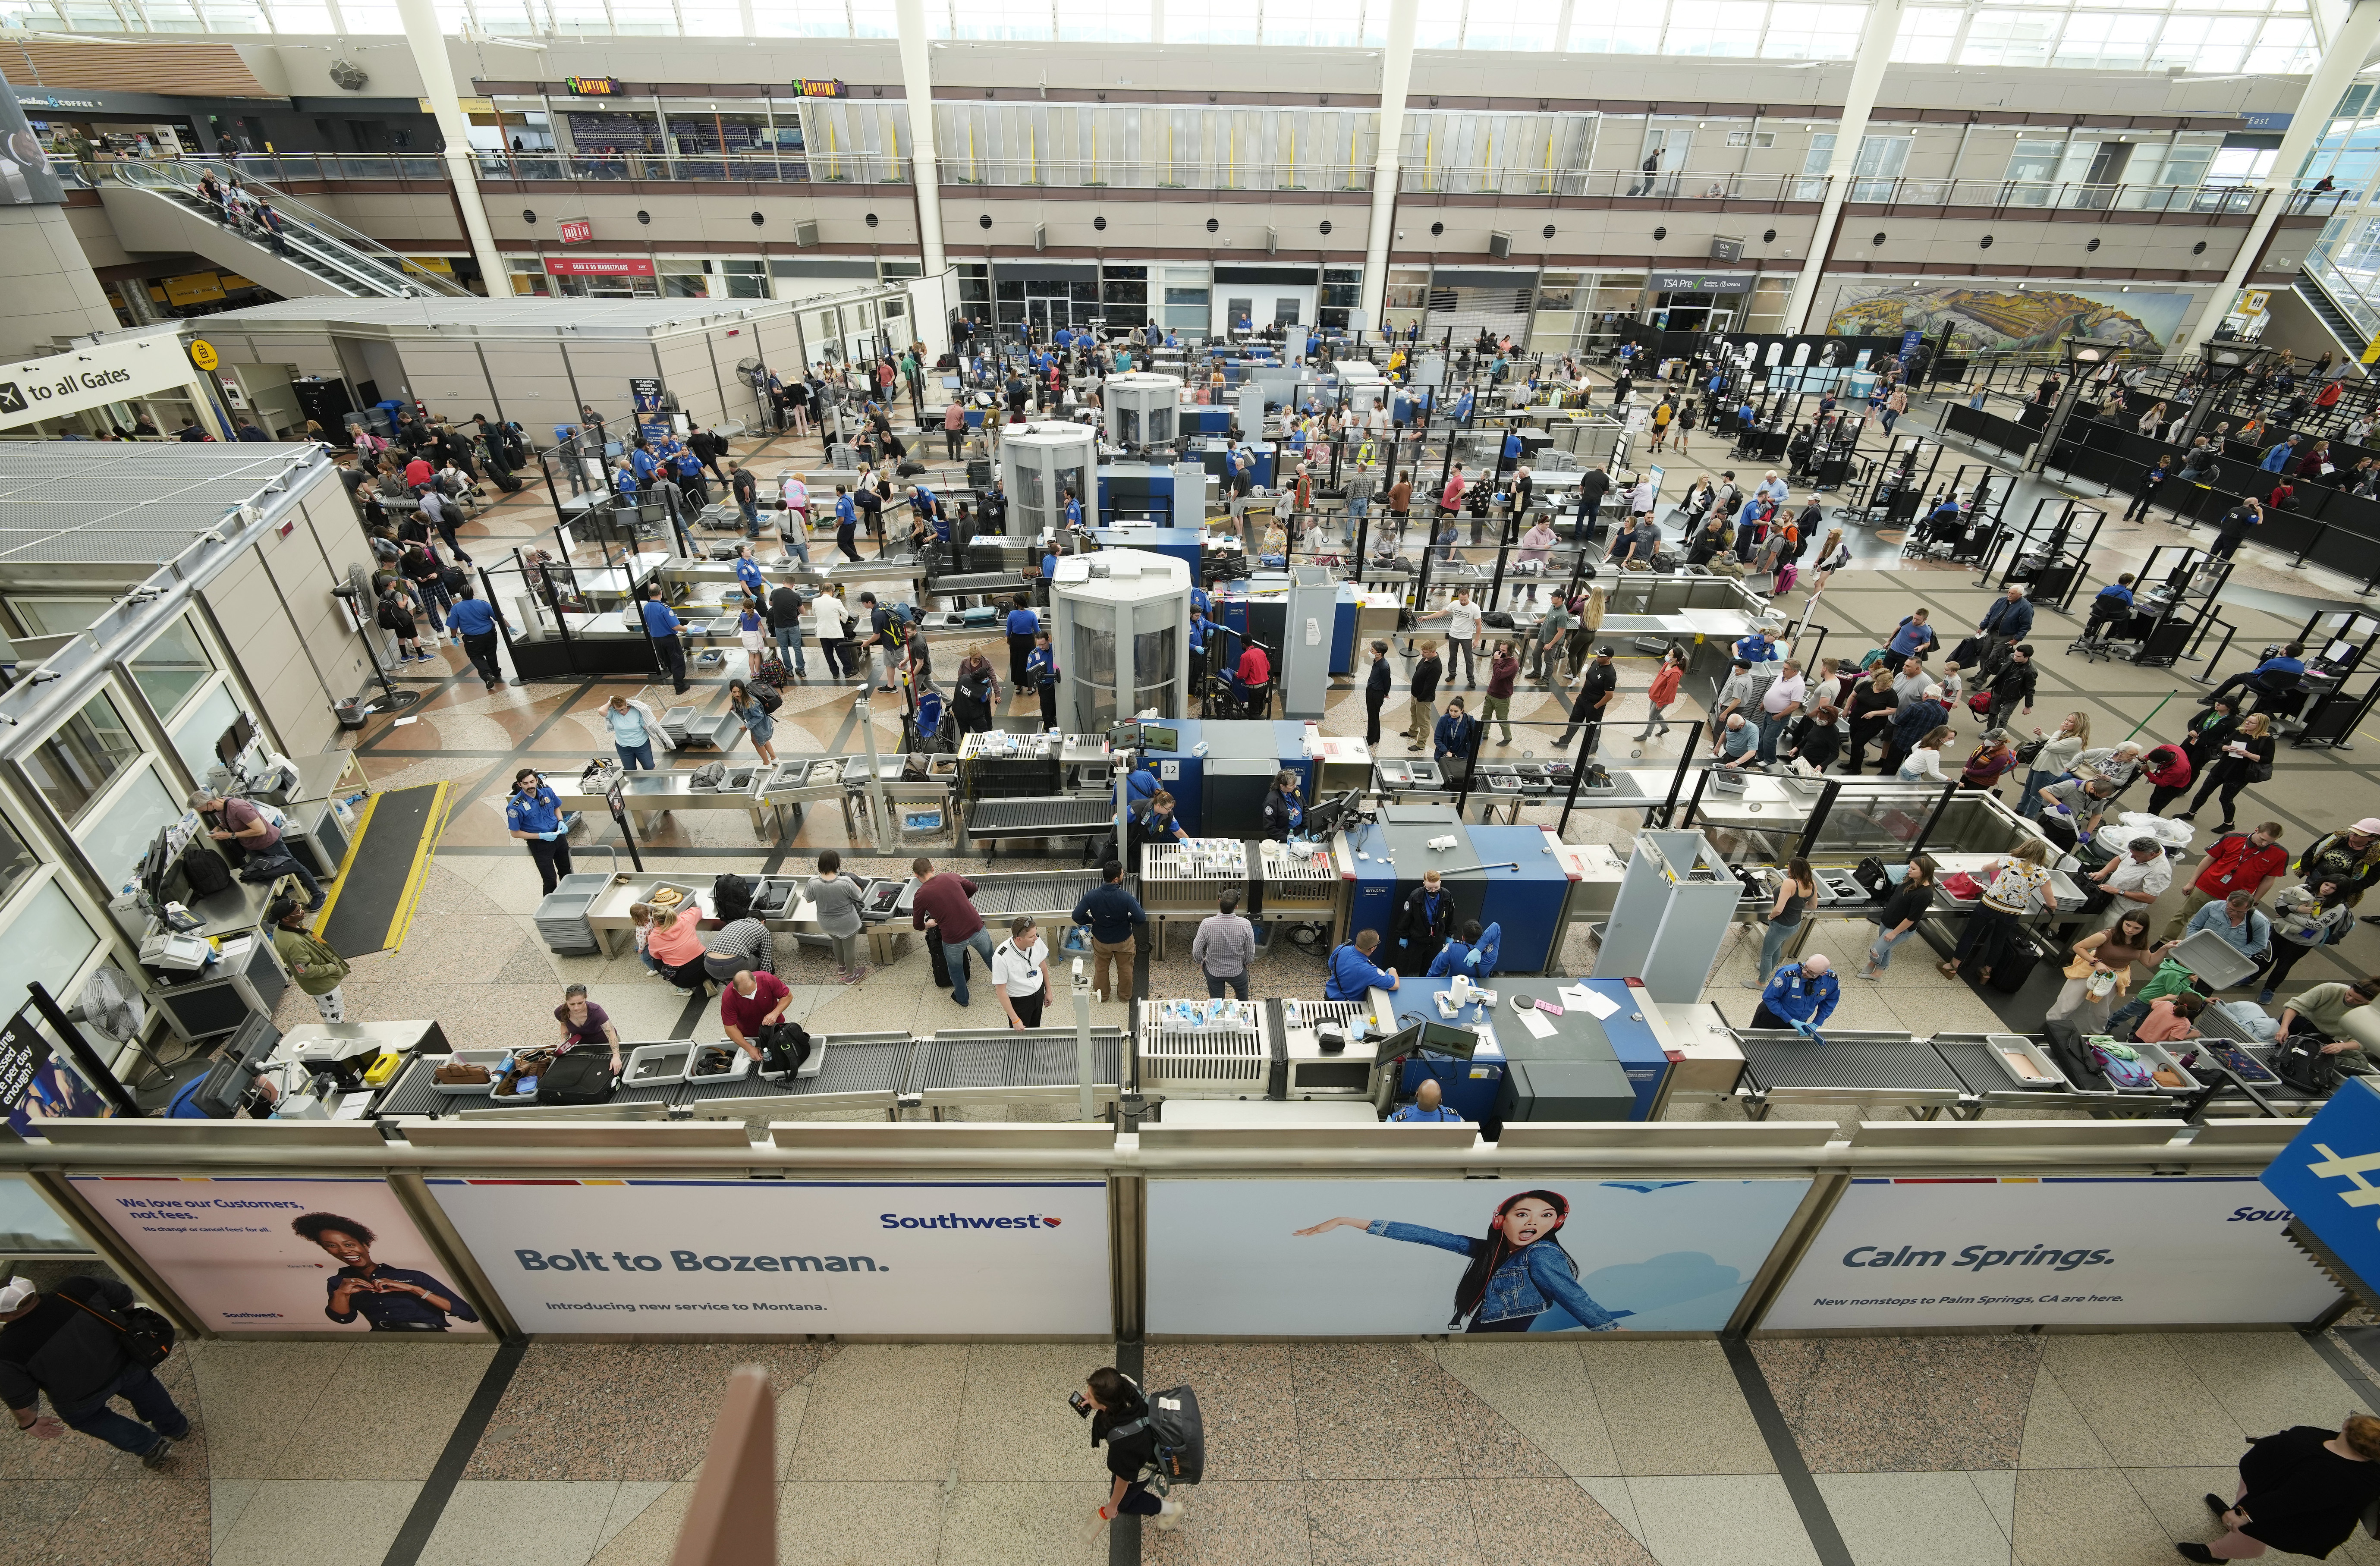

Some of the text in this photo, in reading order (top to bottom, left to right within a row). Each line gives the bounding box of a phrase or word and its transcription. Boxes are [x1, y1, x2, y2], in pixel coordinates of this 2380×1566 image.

[575, 75, 610, 94] CANTINA
[802, 78, 836, 96] CANTINA
[2248, 117, 2270, 125] East
[565, 226, 589, 238] GRAB & GO
[1663, 278, 1693, 288] TSA Pre
[28, 369, 130, 401] to all Gates
[960, 685, 971, 697] TSA
[4, 1063, 19, 1085] per
[16, 1045, 32, 1066] day
[3, 1062, 34, 1105] enough?
[116, 1199, 147, 1207] We
[146, 1199, 182, 1207] love
[214, 1199, 304, 1210] Customers,
[158, 1211, 198, 1219] fees.
[514, 1249, 889, 1272] Bolt to Bozeman.
[1843, 1244, 2114, 1271] Calm Springs.
[546, 1302, 636, 1311] Introducing
[1978, 1296, 2034, 1305] Springs,
